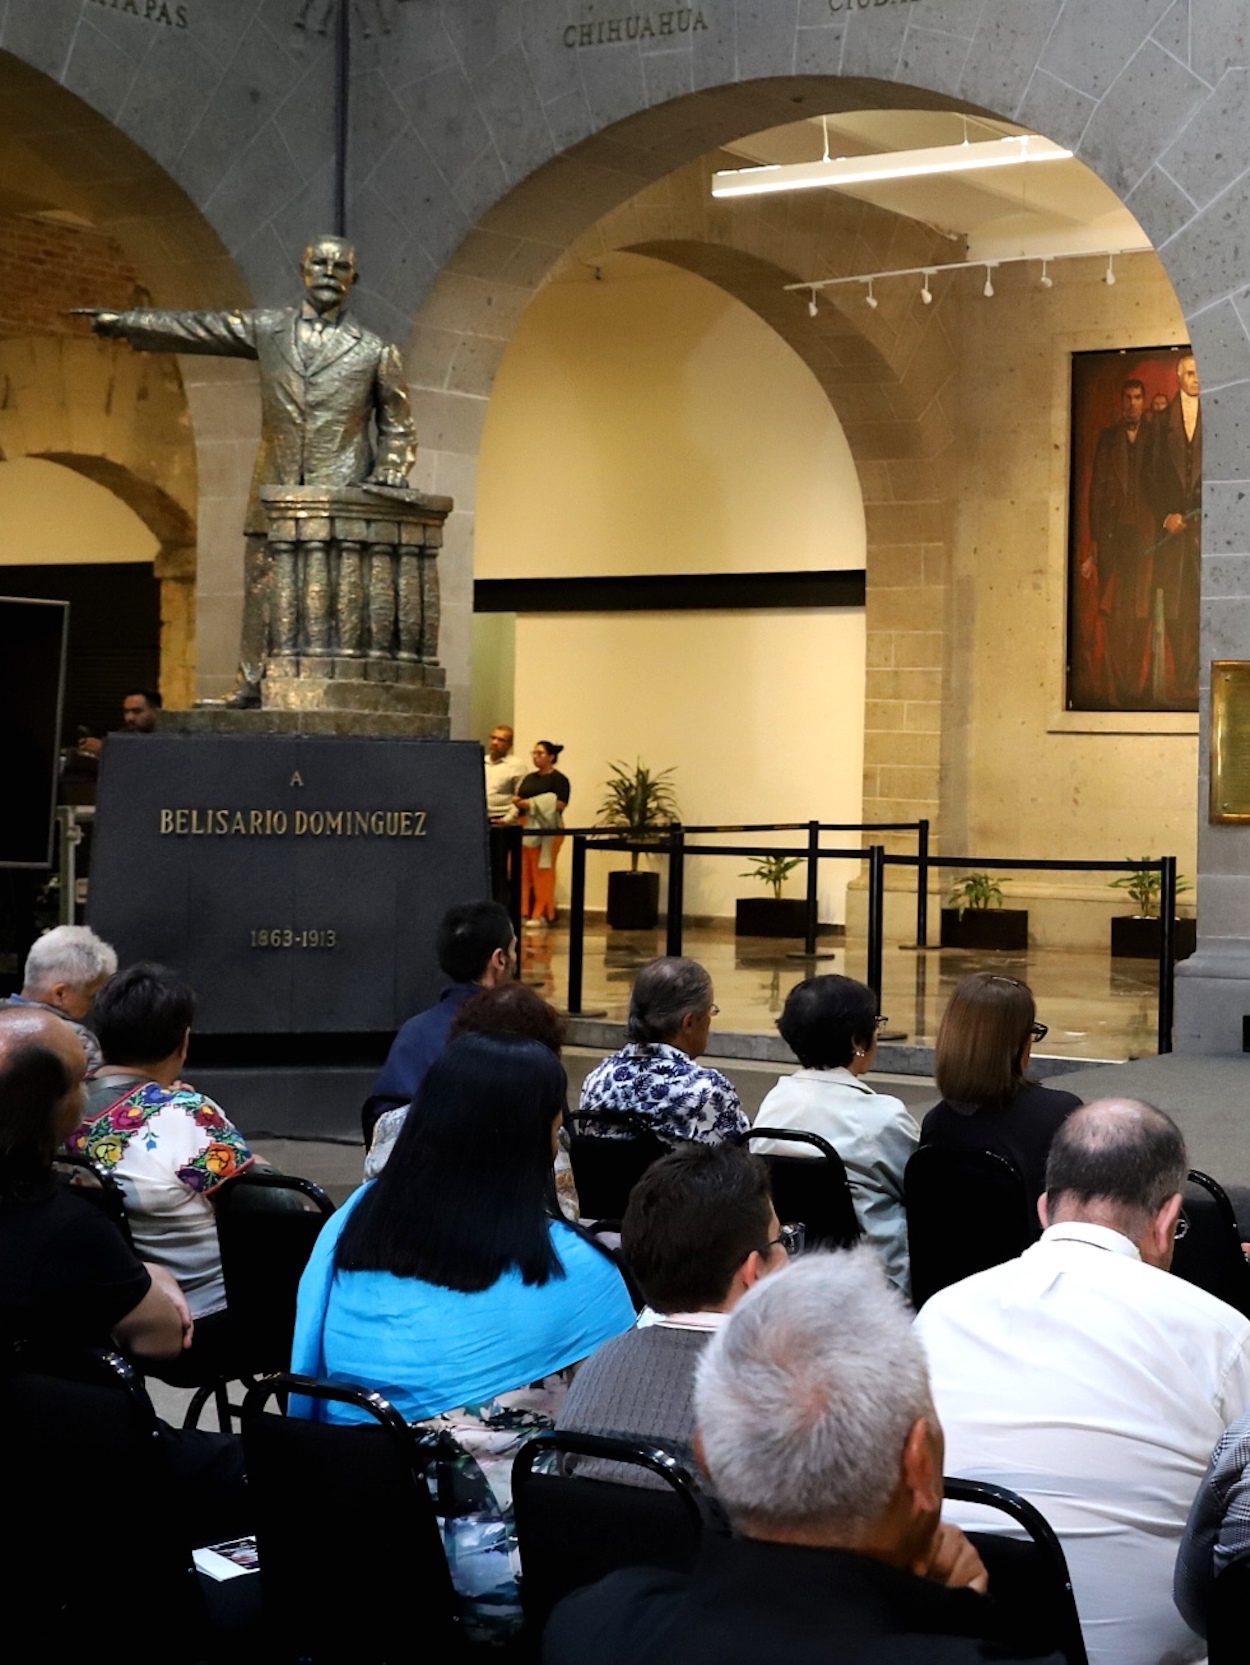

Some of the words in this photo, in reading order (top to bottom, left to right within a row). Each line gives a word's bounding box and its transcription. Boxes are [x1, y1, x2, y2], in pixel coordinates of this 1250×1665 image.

[563, 8, 709, 48] CHIHUAHUA
[289, 769, 304, 787] A
[159, 808, 288, 835] BELISARIO
[294, 809, 427, 836] DOMINGUEZ
[250, 929, 336, 948] 1863-1913
